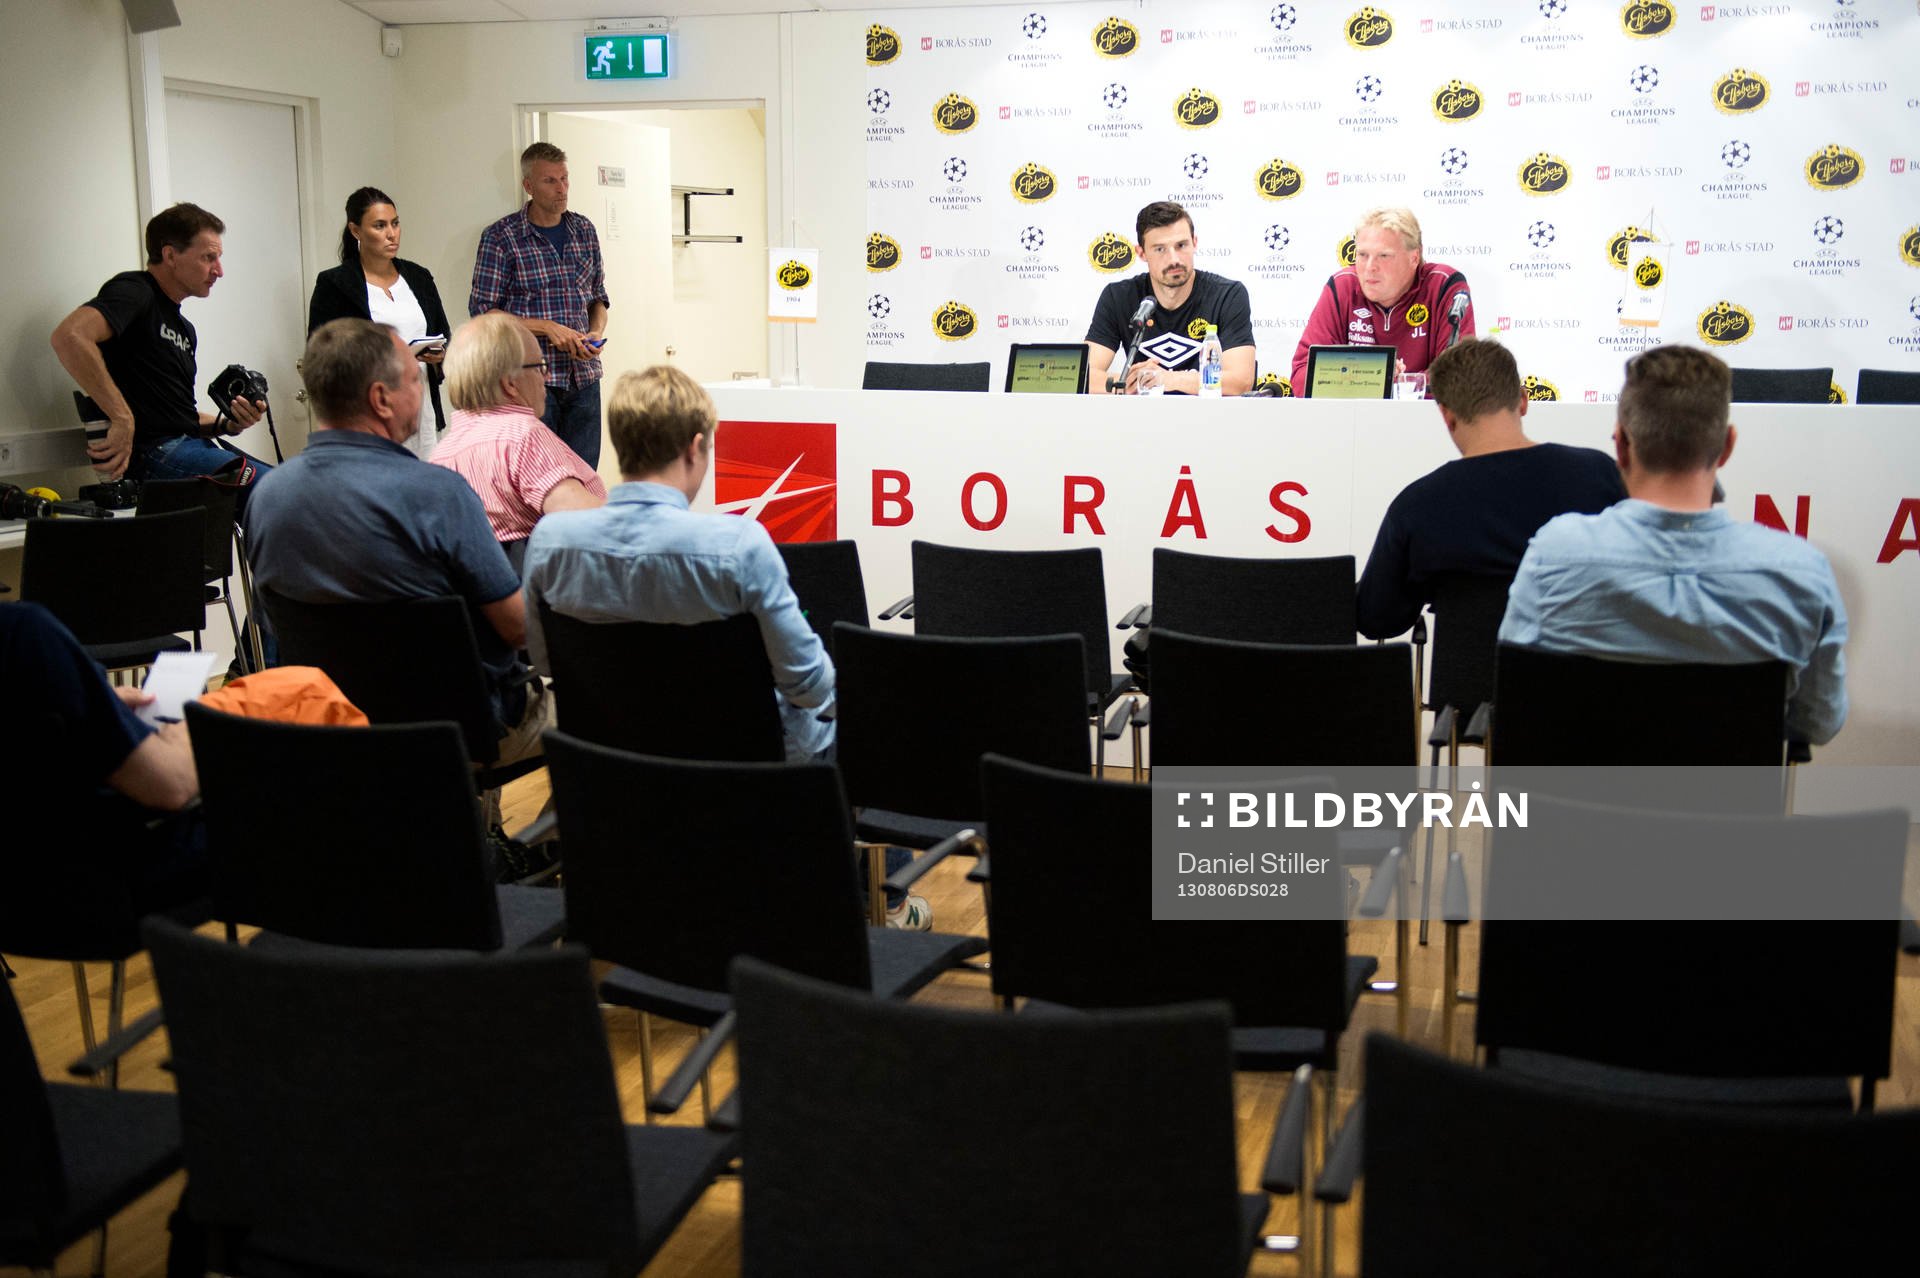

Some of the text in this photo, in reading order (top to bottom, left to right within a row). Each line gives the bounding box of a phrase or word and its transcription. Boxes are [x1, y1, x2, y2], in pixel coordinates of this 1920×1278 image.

[1811, 20, 1880, 31] CHAMPIONS
[1254, 45, 1312, 53] CHAMPIONS
[1611, 108, 1675, 117] CHAMPIONS
[1339, 117, 1398, 125] CHAMPIONS
[1702, 184, 1767, 192] CHAMPIONS
[1167, 194, 1223, 202] CHAMPIONS
[1411, 327, 1427, 338] JL
[160, 323, 194, 356] CRAF
[871, 465, 1312, 543] BORÅS
